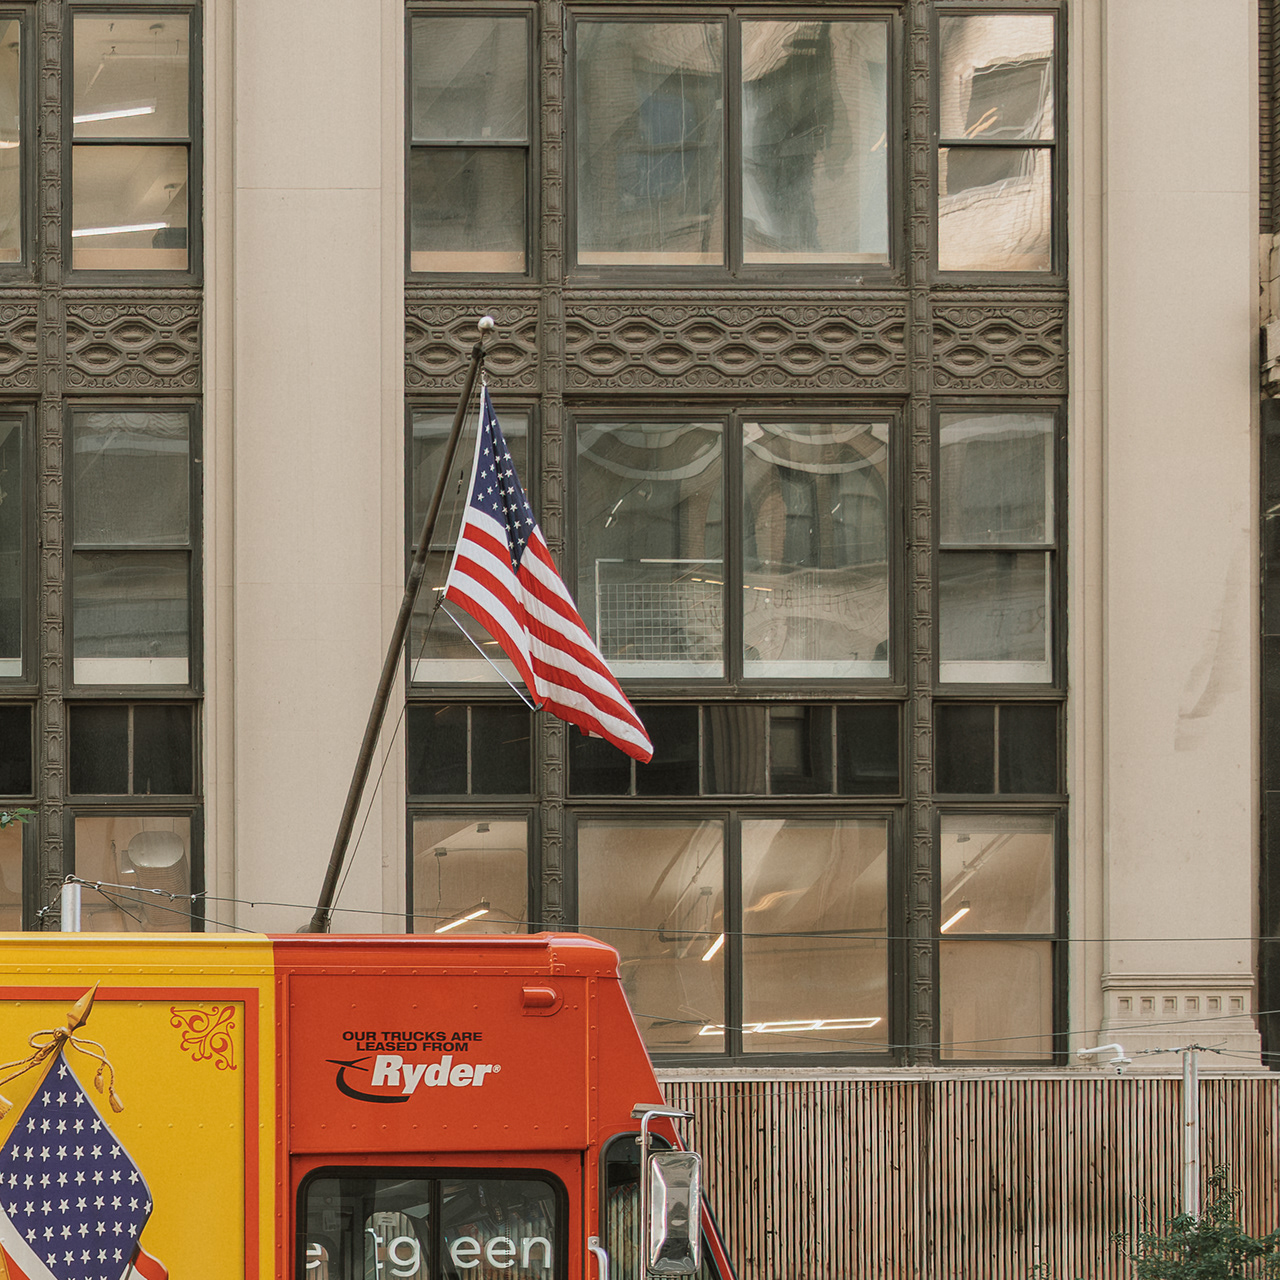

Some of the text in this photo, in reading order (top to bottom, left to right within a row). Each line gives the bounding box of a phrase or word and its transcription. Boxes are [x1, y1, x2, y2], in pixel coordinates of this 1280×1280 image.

[342, 1031, 483, 1042] OUR TRUCKS ARE
[356, 1042, 469, 1052] LEASED FROM
